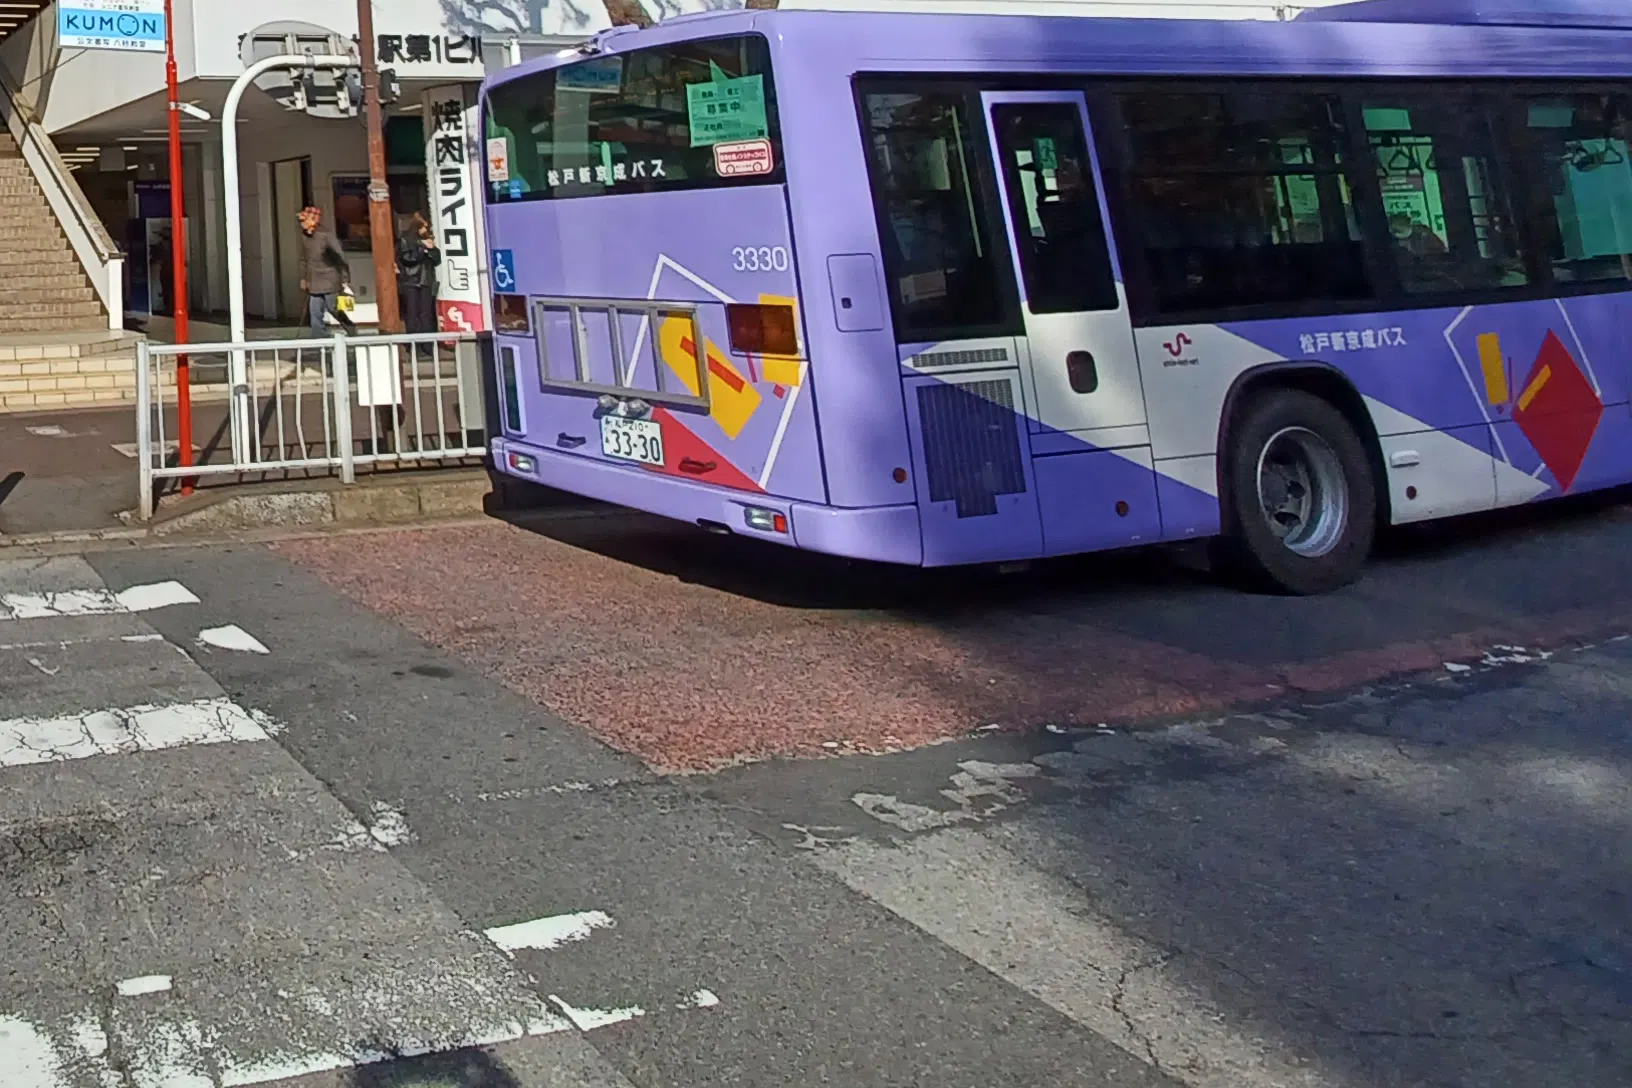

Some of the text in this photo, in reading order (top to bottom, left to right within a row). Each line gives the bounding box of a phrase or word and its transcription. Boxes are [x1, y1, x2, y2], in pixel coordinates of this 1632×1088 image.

[66, 13, 157, 37] KUMON
[547, 159, 666, 186] 松戸新京成バス
[732, 247, 788, 272] 3330
[1299, 327, 1408, 354] 松戸新京成バス
